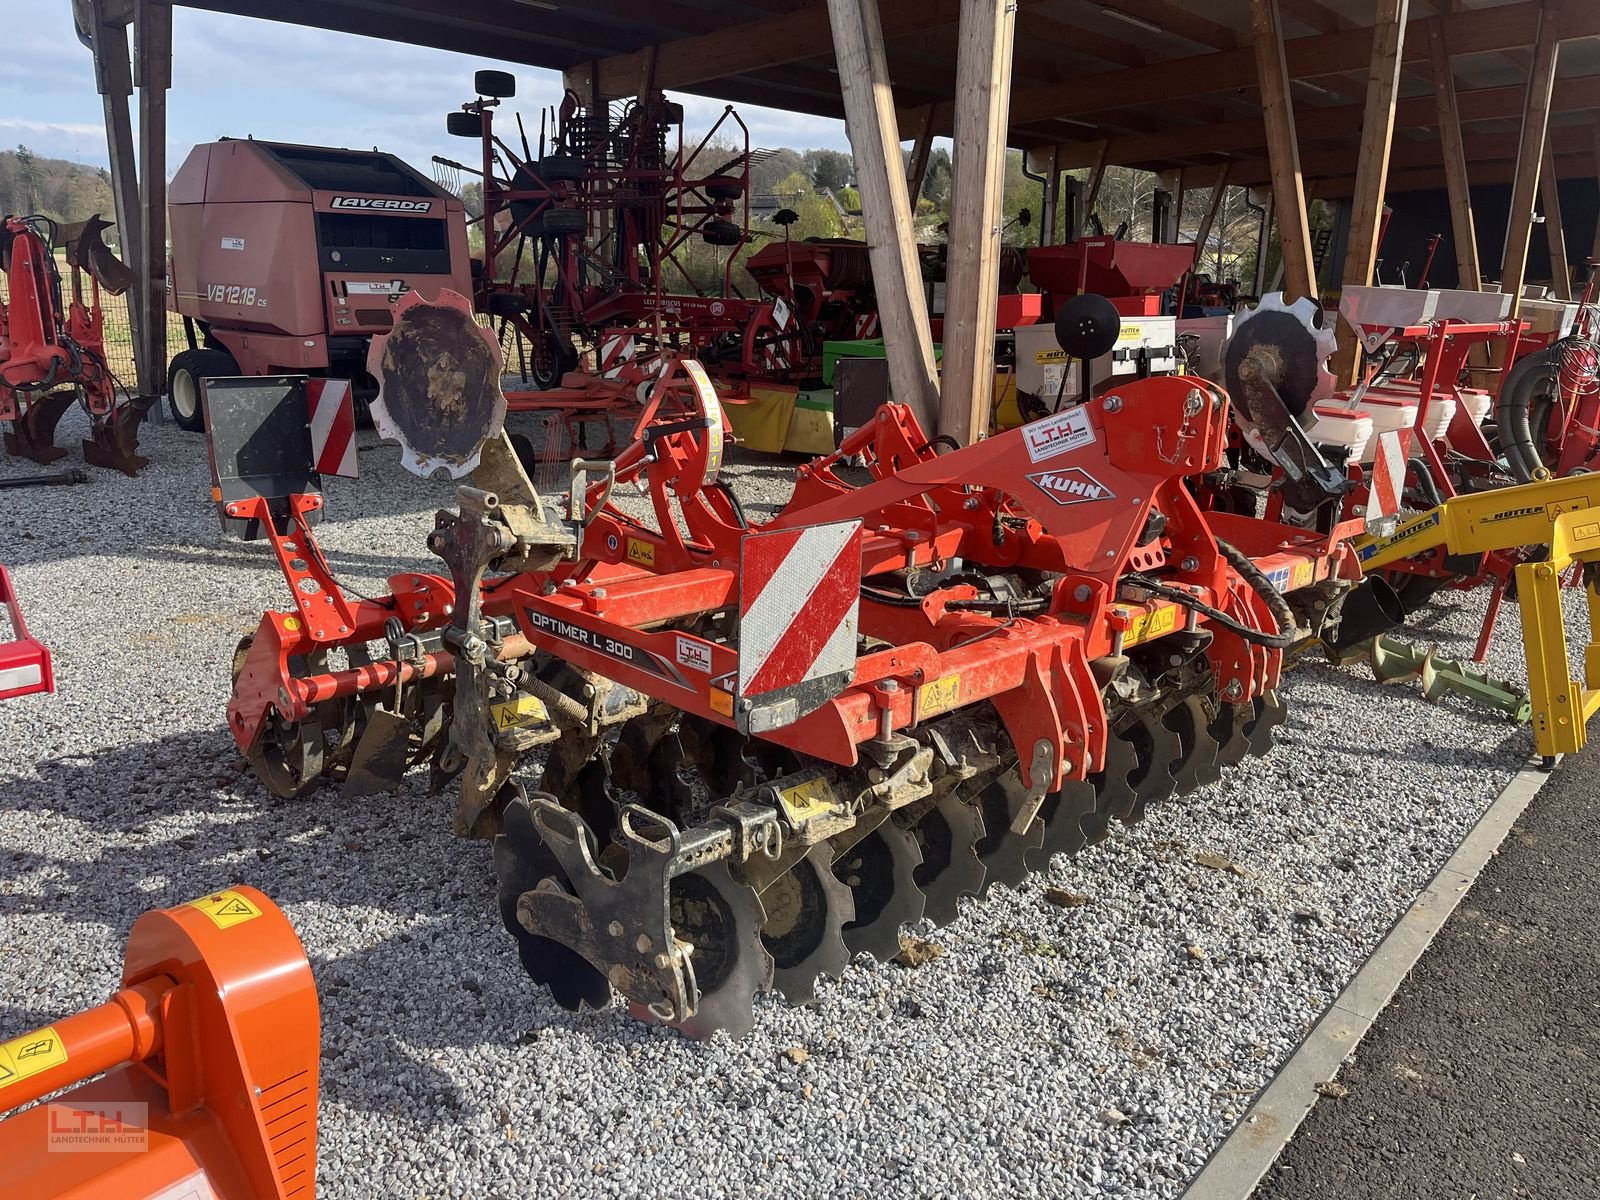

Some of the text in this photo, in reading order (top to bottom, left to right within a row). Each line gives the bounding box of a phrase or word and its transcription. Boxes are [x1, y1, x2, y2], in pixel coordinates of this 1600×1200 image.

[332, 197, 431, 213] LAVERDA
[660, 299, 681, 307] IBISCUS
[712, 434, 719, 447] 3
[1034, 438, 1069, 454] LANDTECHNIK
[711, 455, 717, 467] 1
[1040, 474, 1101, 499] KUHN
[532, 612, 633, 660] OPTIMER L 300
